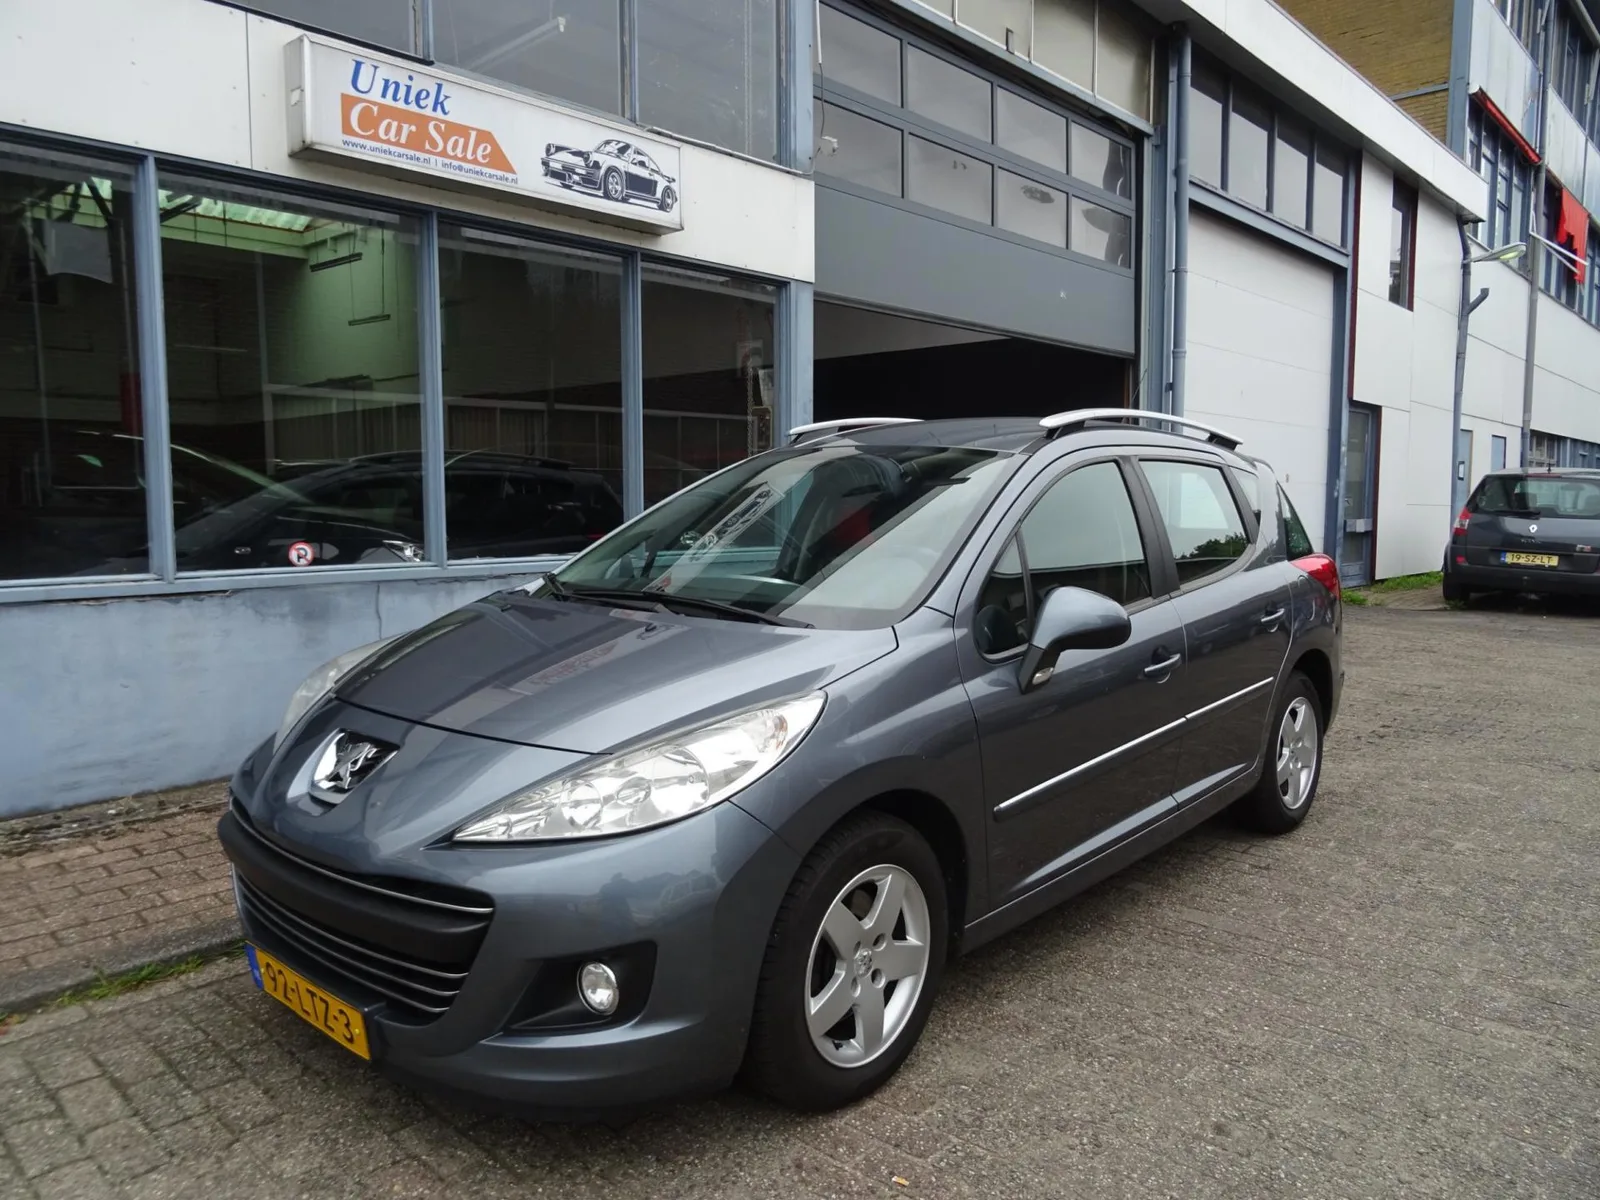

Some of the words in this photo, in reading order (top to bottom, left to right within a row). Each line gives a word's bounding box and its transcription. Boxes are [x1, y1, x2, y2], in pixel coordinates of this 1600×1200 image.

[351, 59, 451, 116] Uniek
[342, 138, 431, 165] www.uniekcarsale.nl
[441, 159, 518, 185] info@uniekcarsale.nl
[349, 102, 416, 145] Car
[424, 120, 492, 164] Sale
[1510, 553, 1552, 564] 19-SZ-LT
[265, 961, 354, 1044] 92-LTZ-3
